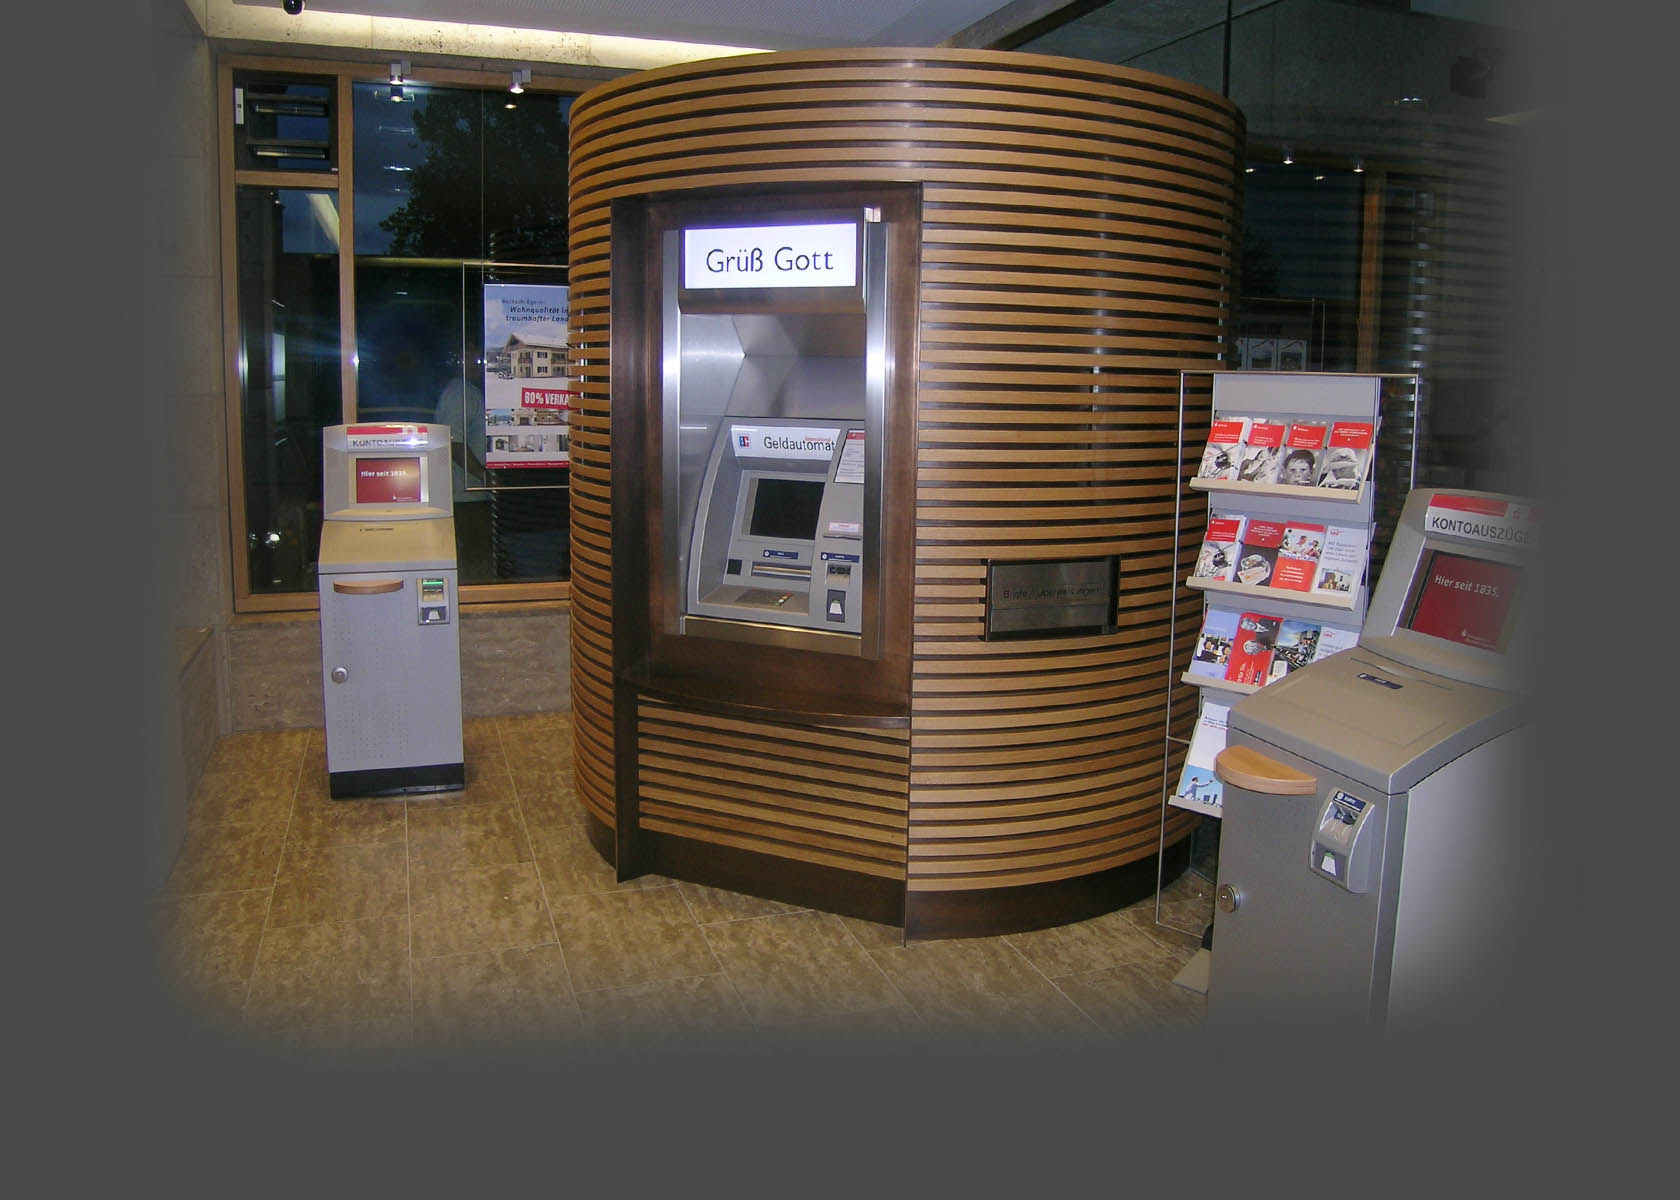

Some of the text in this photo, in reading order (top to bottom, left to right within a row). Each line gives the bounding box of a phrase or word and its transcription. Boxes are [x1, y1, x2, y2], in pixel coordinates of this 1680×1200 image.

[706, 246, 834, 273] Grüß Gott
[763, 436, 836, 452] Geldautomat
[1434, 575, 1454, 588] Hier
[1454, 580, 1473, 593] seit
